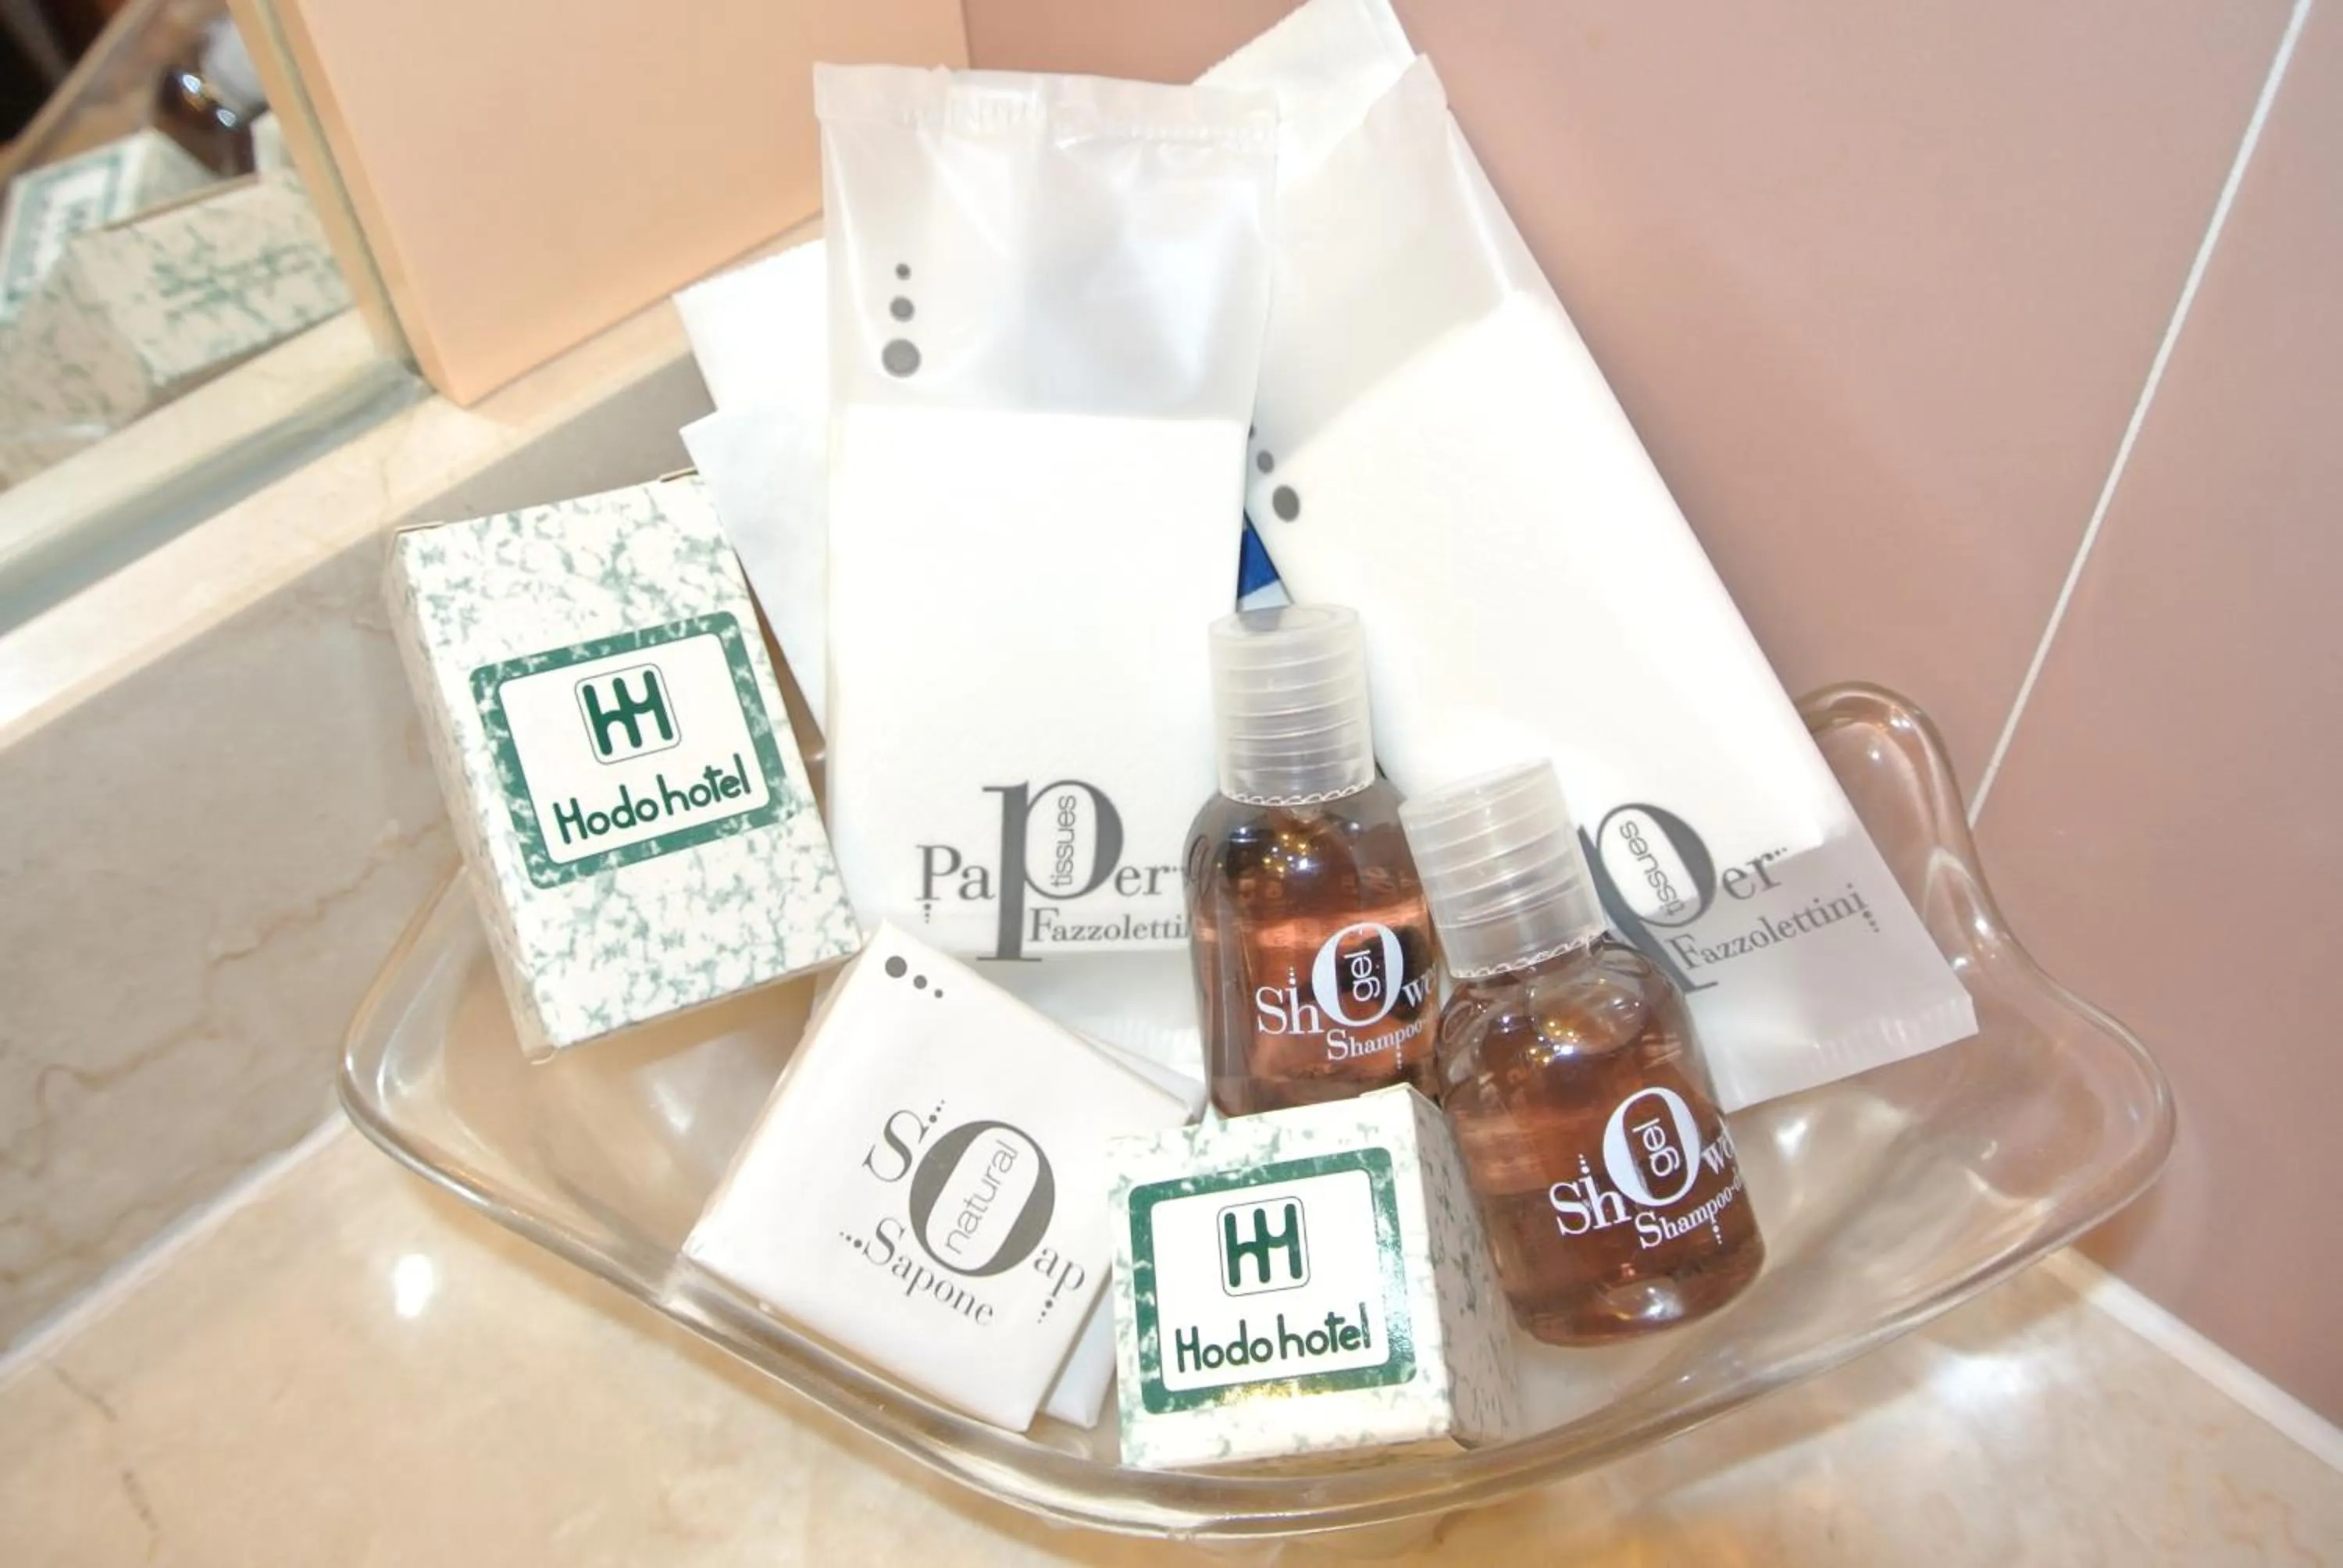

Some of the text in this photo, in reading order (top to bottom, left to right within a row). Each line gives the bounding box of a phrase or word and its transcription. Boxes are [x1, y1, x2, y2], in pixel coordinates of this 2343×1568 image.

[1050, 794, 1077, 888] tissues
[1619, 820, 1685, 917] tissues
[1028, 907, 1189, 943] Fazzoletti
[1665, 883, 1869, 970] Fazzolettini
[1343, 950, 1381, 1003] gel
[1632, 1117, 1680, 1177] gel
[944, 1139, 1018, 1255] natural
[861, 1217, 993, 1326] Sapone
